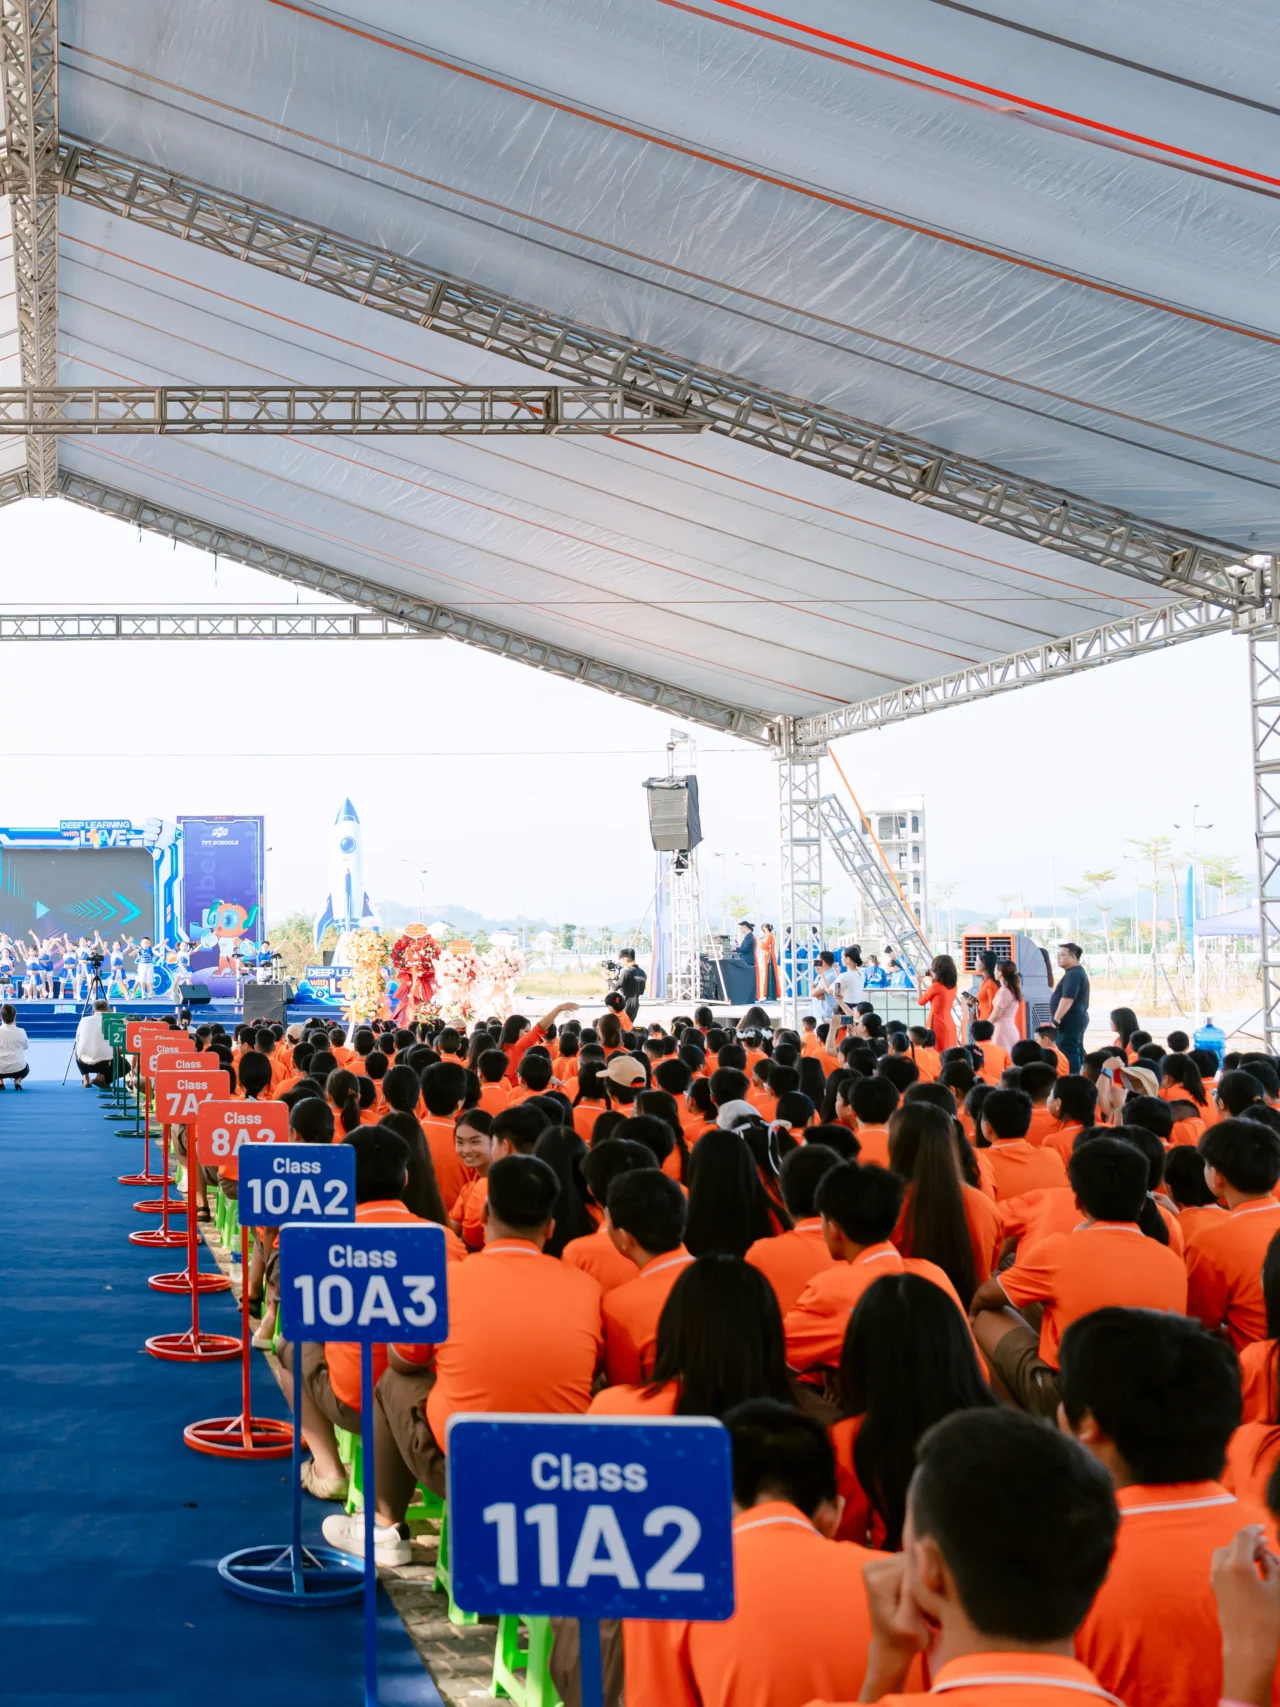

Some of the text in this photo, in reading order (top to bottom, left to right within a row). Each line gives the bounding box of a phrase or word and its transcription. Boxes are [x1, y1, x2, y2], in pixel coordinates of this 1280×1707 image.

[61, 821, 130, 829] DEEP LEARNING
[308, 968, 335, 977] DEEP
[176, 1060, 202, 1069] Class
[177, 1080, 208, 1090] Class
[166, 1093, 213, 1116] 7A
[224, 1112, 262, 1125] Class
[273, 1158, 322, 1174] Class
[247, 1179, 349, 1216] 10A2
[328, 1244, 398, 1269] Class
[293, 1274, 438, 1327] 10A3
[531, 1452, 648, 1493] Class
[483, 1502, 705, 1592] 11A2
